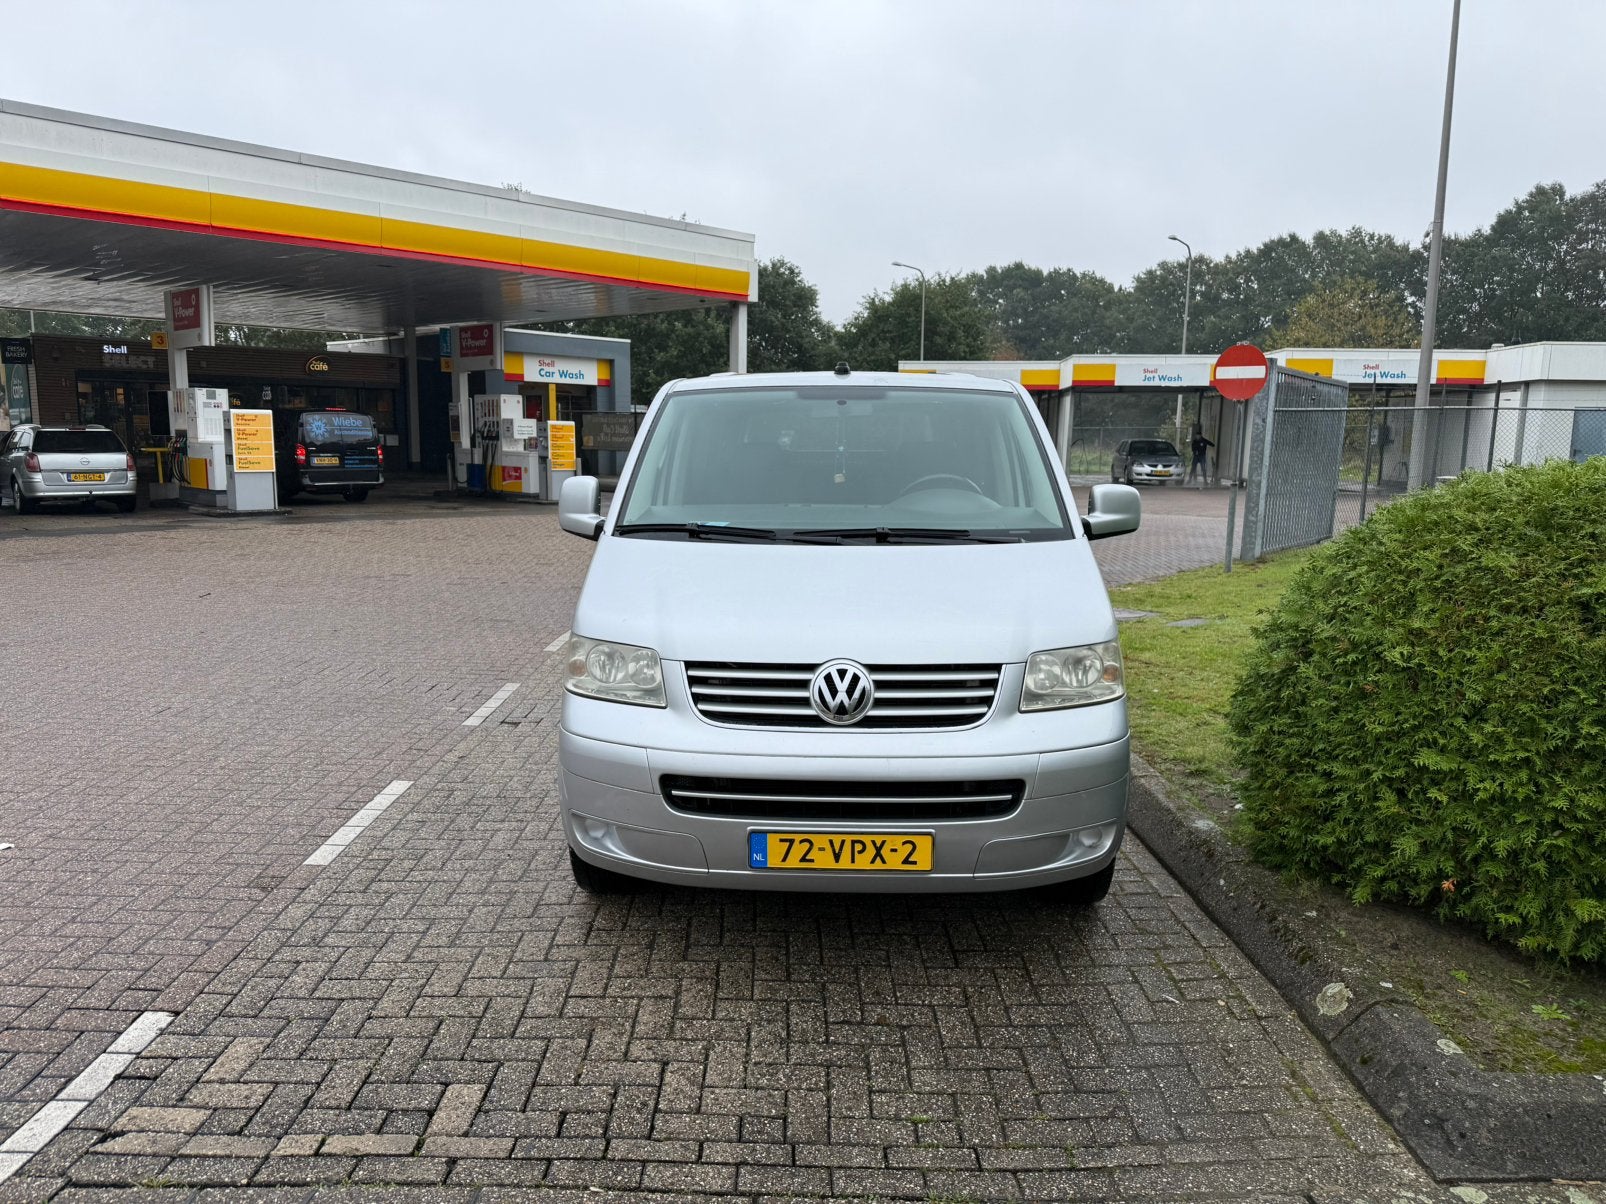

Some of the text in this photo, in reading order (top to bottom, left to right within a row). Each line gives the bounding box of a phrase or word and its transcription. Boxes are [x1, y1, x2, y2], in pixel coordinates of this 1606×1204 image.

[156, 335, 165, 346] 3
[462, 338, 487, 348] V-Power
[103, 345, 128, 354] Shell
[538, 359, 556, 368] Shell
[538, 368, 585, 380] Car Wash
[1142, 373, 1183, 382] Jet Wash
[1379, 370, 1406, 379] Wash
[332, 416, 363, 427] Wiebe
[753, 838, 919, 866] NL 72-VPX-2
